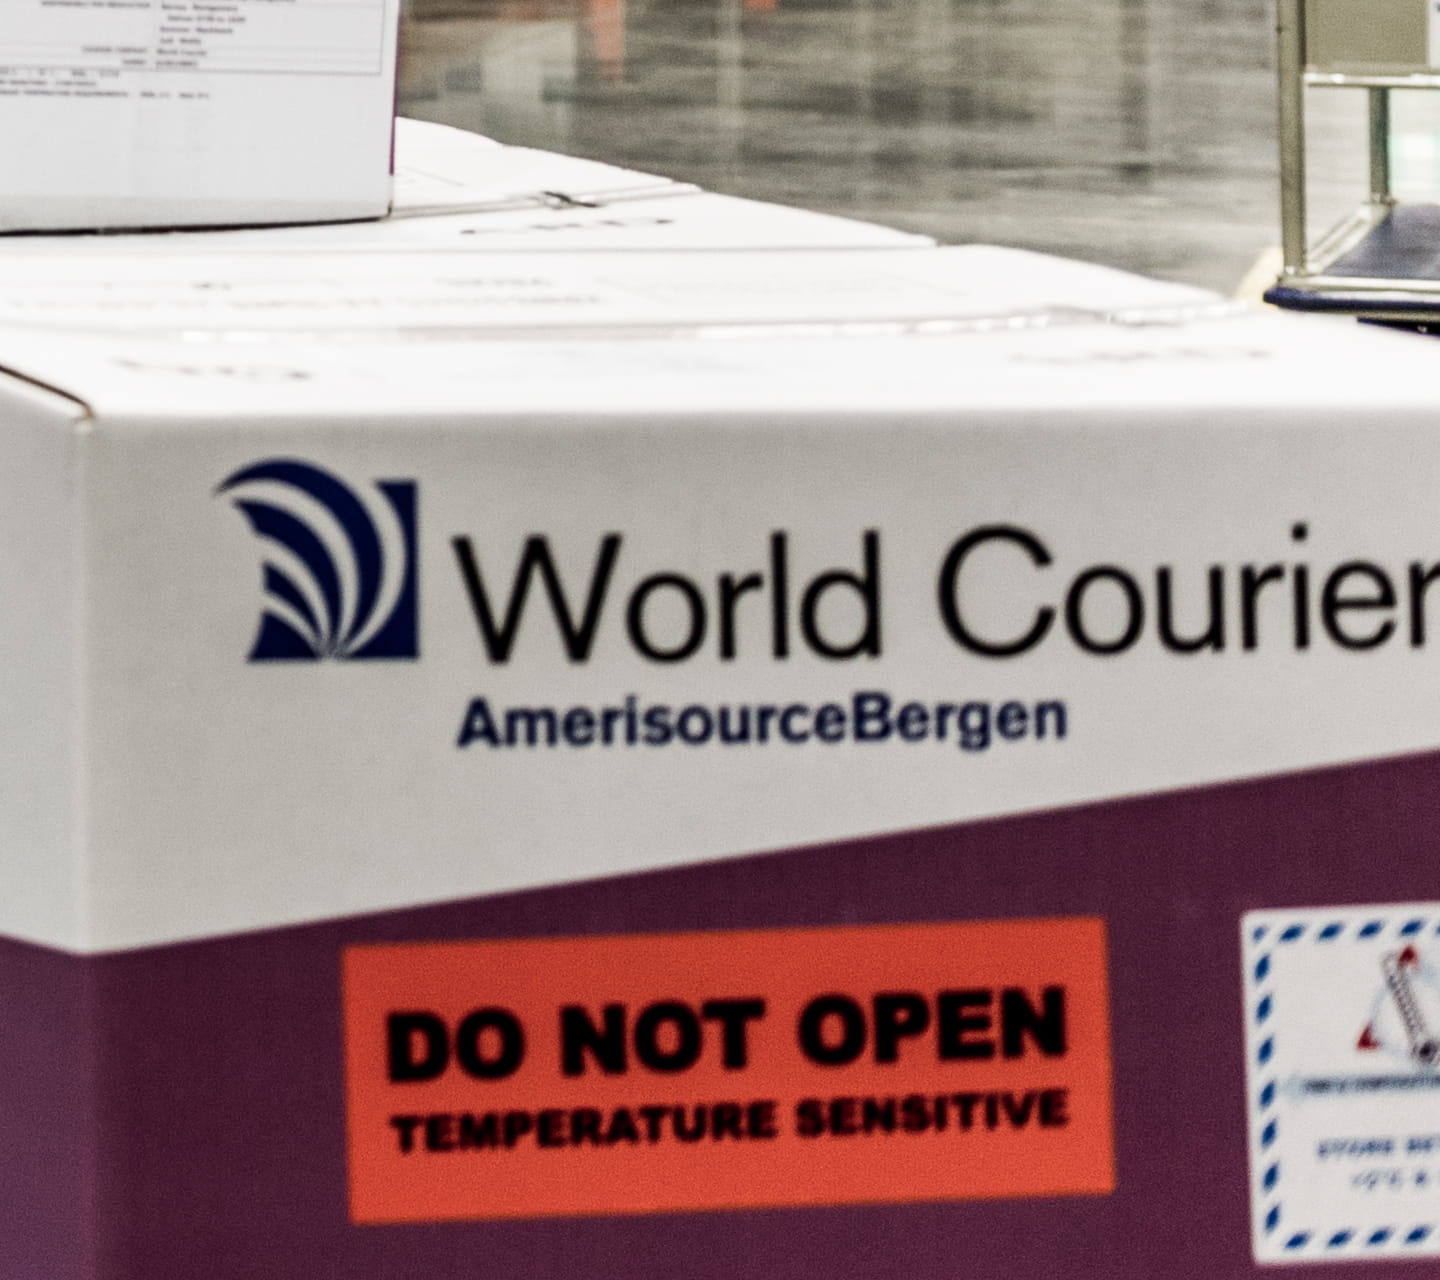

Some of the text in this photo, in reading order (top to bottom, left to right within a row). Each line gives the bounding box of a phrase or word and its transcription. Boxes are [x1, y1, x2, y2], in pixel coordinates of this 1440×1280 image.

[452, 522, 1440, 666] World Courier
[455, 690, 1070, 752] AmerisourceBergen
[384, 985, 1070, 1084] DO NOT OPEN
[390, 1088, 1072, 1155] TEMPERATURE SENSITIVE
